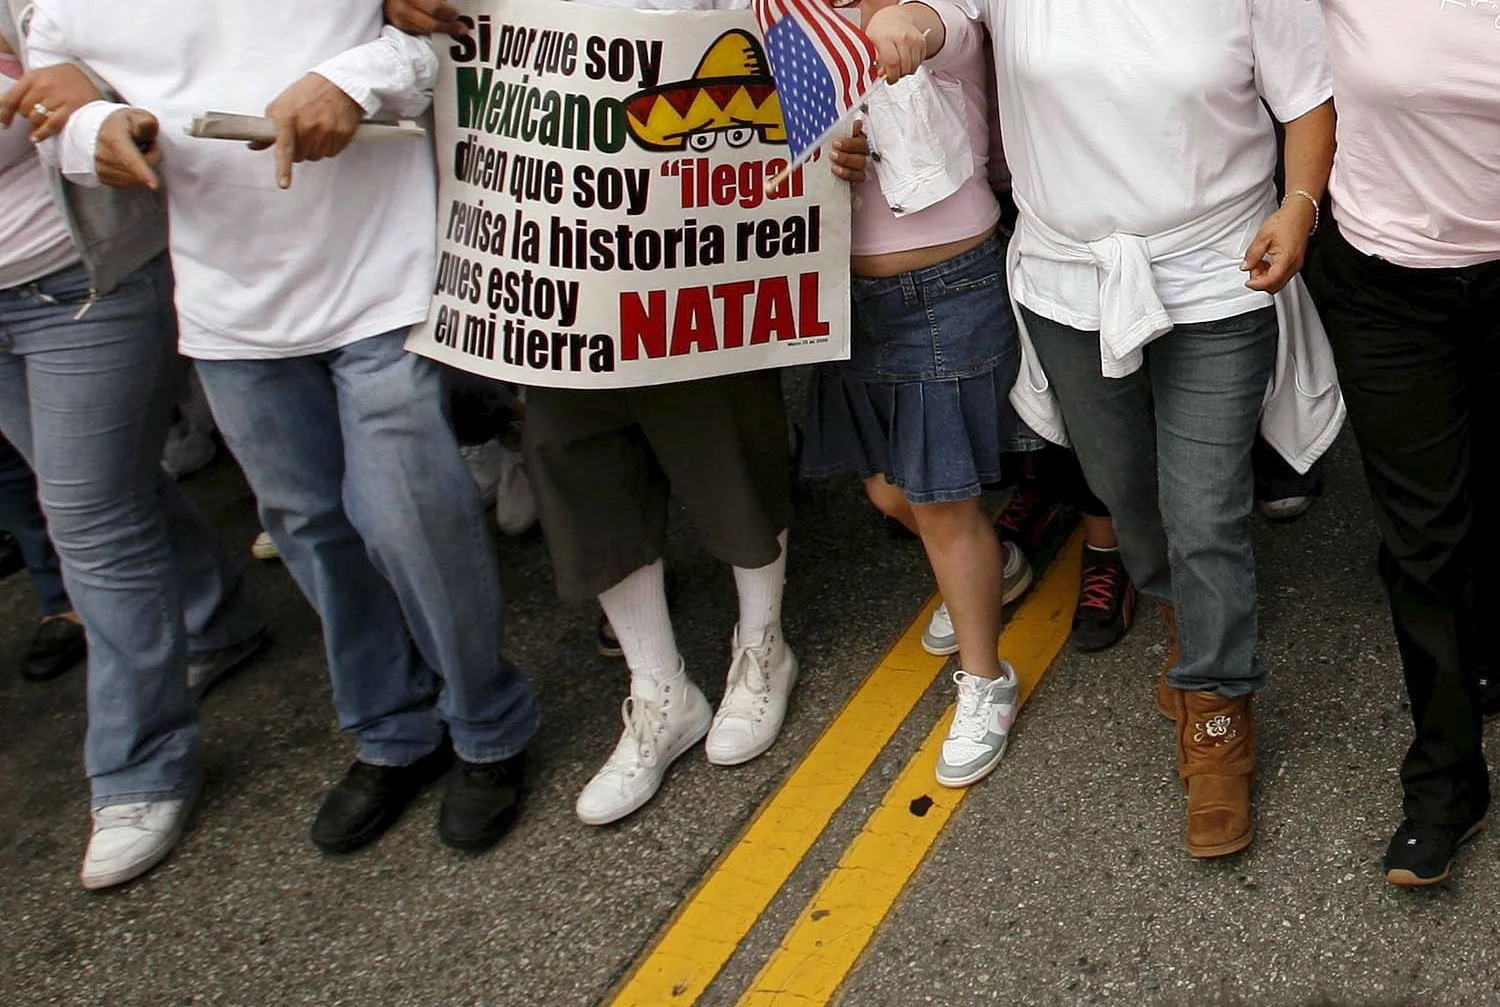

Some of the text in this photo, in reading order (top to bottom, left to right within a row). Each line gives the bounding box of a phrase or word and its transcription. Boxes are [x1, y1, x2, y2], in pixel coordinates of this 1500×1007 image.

[450, 14, 664, 89] Si por que soy
[456, 67, 627, 154] Mexicano
[455, 134, 508, 193] dicen
[510, 153, 564, 205] que
[573, 164, 651, 216] soy
[446, 199, 821, 272] revisa la historia real
[434, 271, 830, 373] en mi tierra NATAL
[436, 251, 580, 327] pues estoy
